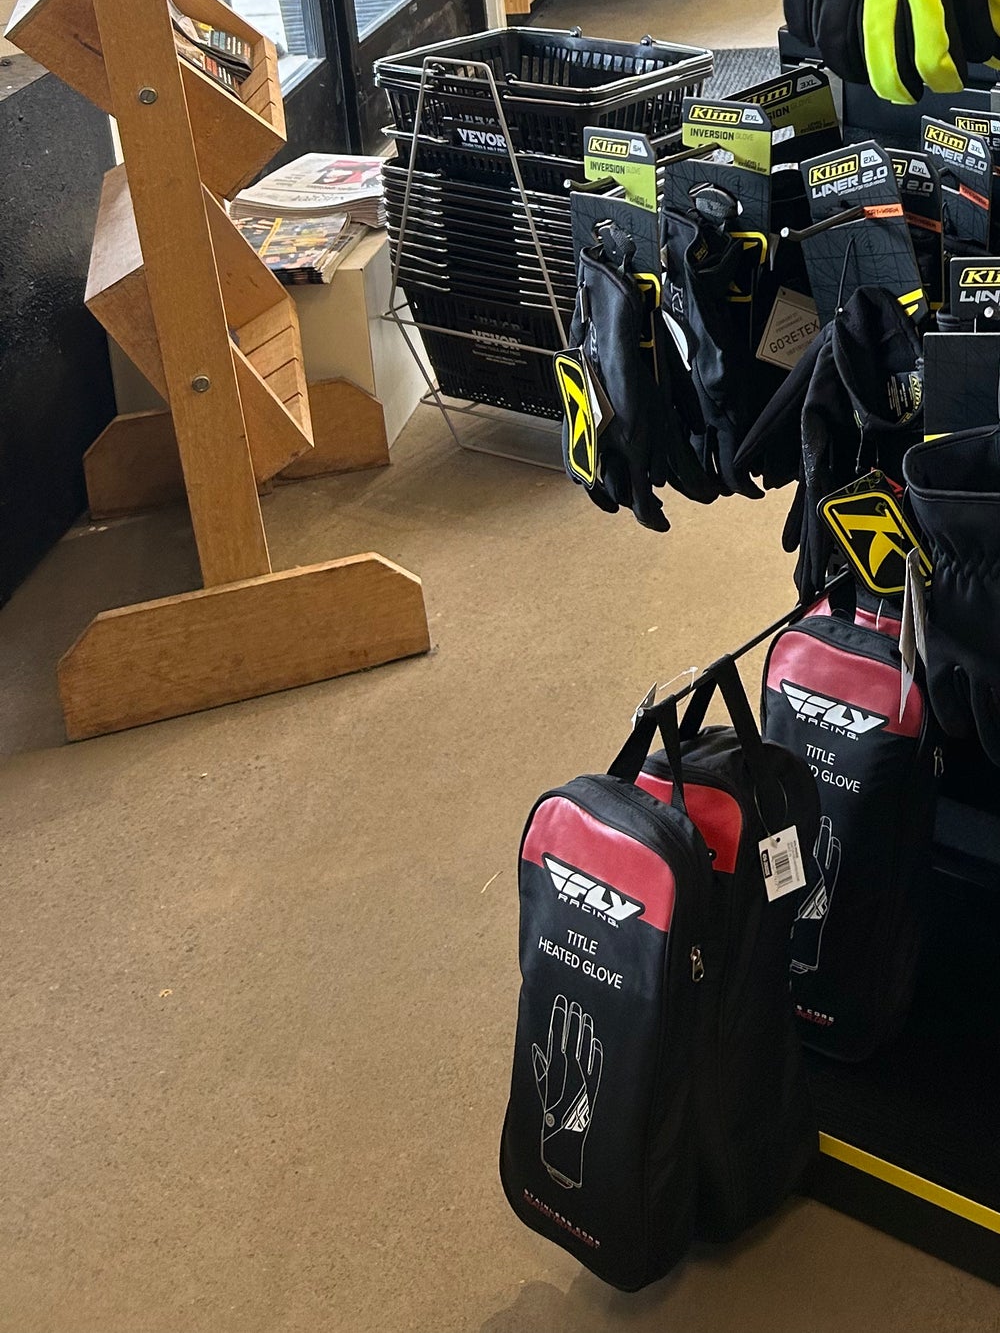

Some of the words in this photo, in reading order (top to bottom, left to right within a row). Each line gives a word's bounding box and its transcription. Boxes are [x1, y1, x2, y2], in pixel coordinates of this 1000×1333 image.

[457, 128, 507, 147] VEVOR
[690, 128, 735, 141] INVERSION
[590, 161, 625, 174] INVERSION
[924, 142, 964, 163] LINER
[965, 156, 988, 172] 2.0
[812, 176, 858, 199] LINER
[862, 166, 888, 183] 2.0
[787, 687, 885, 734] FLY
[796, 713, 857, 740] RACING
[806, 744, 836, 766] TITLE
[821, 770, 861, 794] GLOVE
[550, 863, 641, 921] FLY
[558, 893, 617, 927] RACING
[567, 930, 598, 955] TITLE
[538, 936, 580, 968] HEATED
[582, 960, 623, 989] GLOVE
